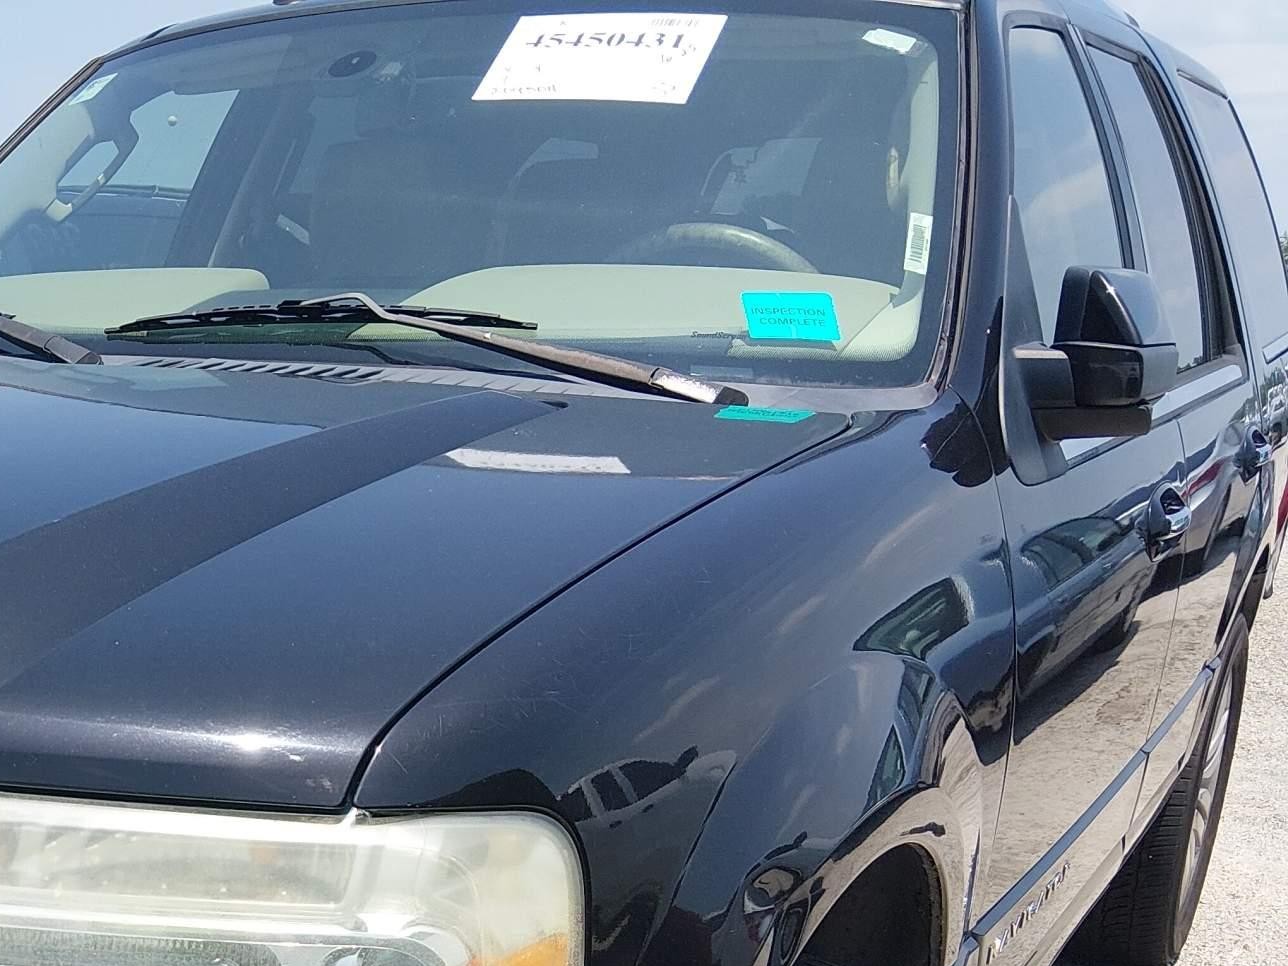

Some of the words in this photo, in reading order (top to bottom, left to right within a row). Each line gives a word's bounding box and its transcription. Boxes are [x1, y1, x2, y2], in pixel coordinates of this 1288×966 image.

[525, 32, 684, 49] 45450431
[751, 306, 826, 317] INSPECTION
[759, 317, 826, 327] COMPLETE
